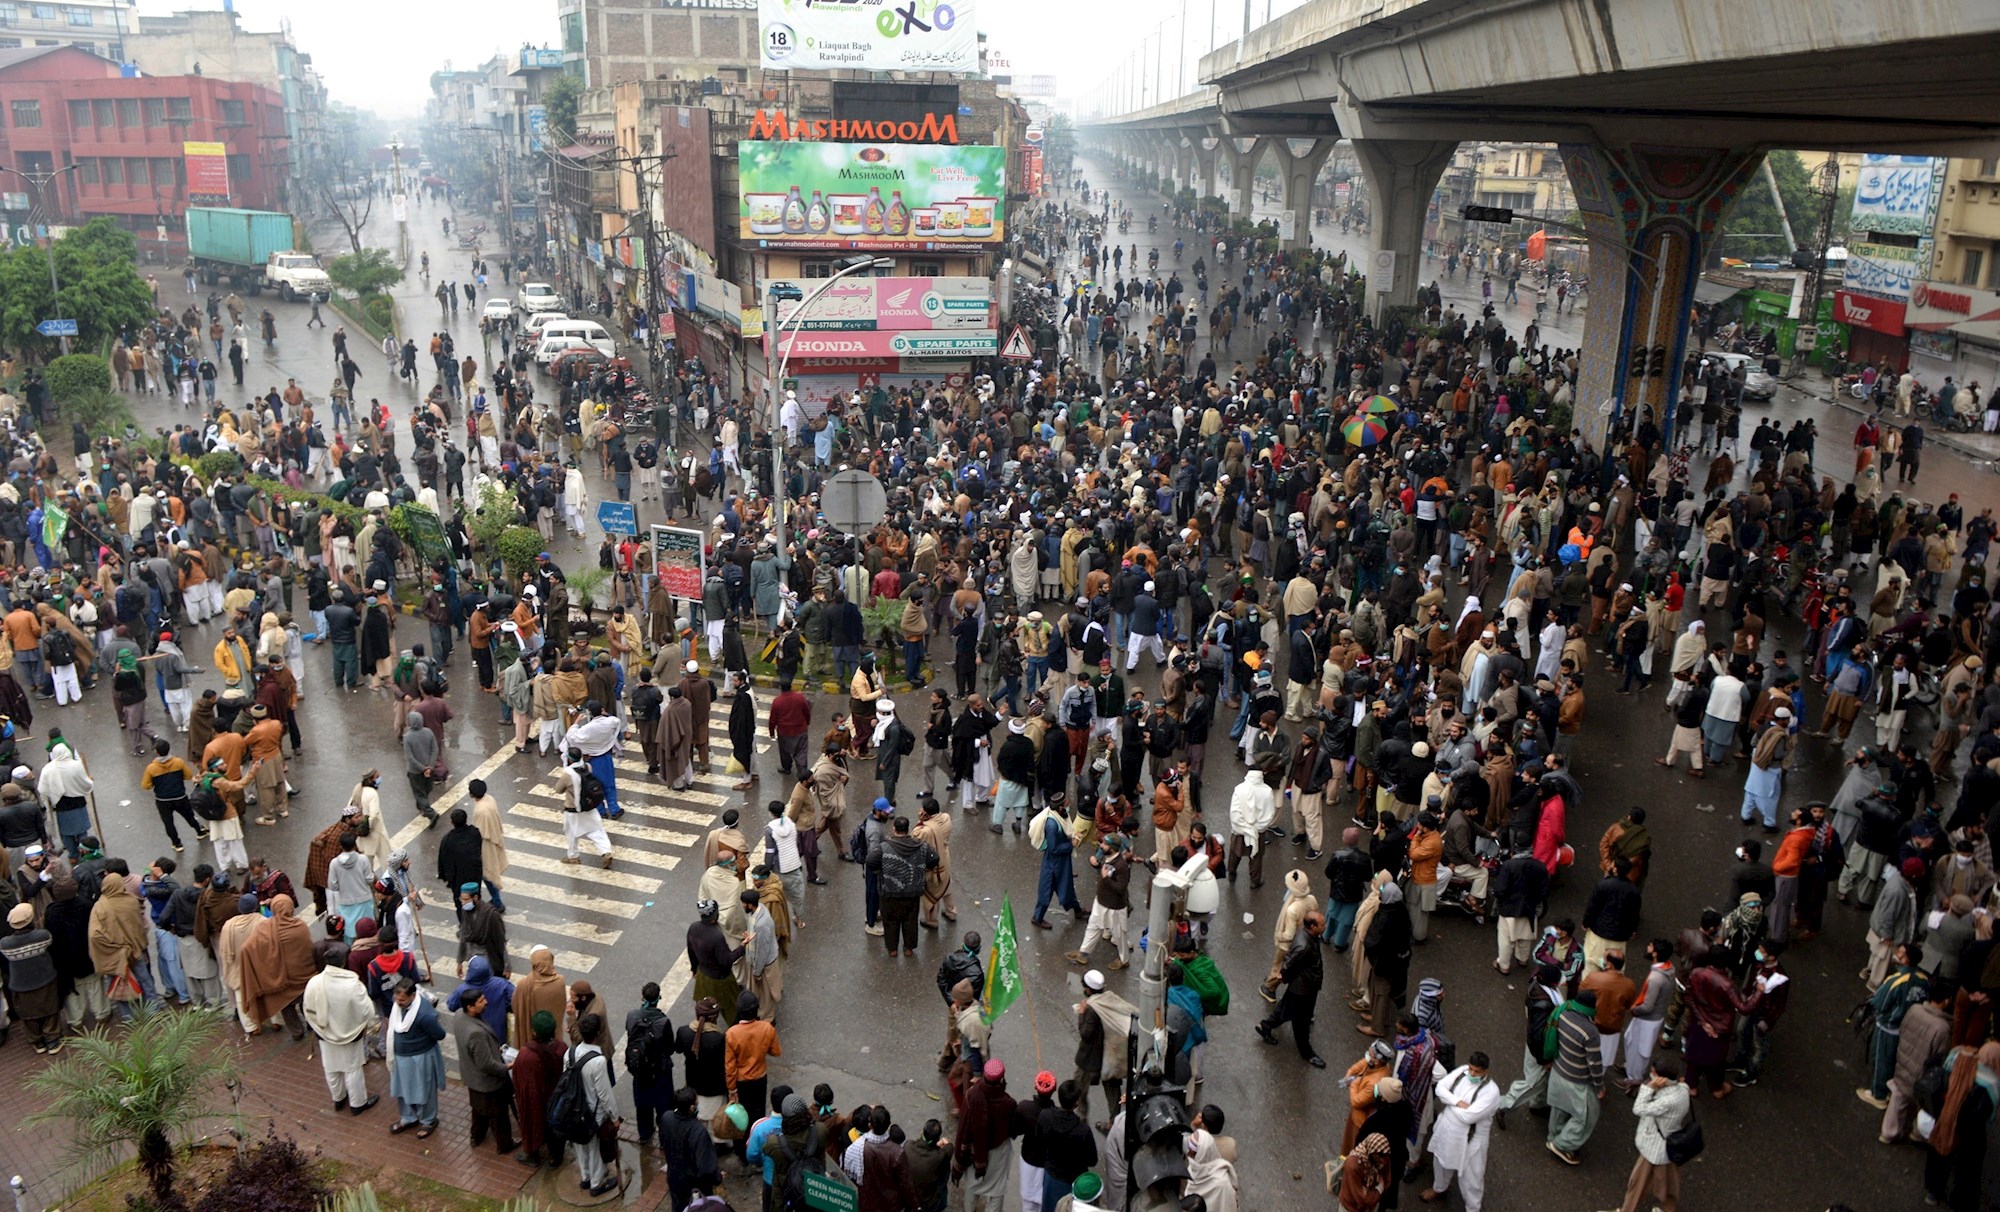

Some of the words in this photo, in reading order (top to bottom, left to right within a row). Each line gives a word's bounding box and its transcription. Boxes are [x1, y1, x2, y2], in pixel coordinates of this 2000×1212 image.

[770, 32, 787, 45] 18
[819, 41, 849, 51] Liaquat
[852, 42, 872, 52] Bagh
[819, 52, 864, 62] Rawalpindi
[988, 60, 1010, 68] OTEL
[931, 167, 944, 175] Eat
[946, 167, 965, 176] Well,
[938, 174, 955, 182] Live
[957, 174, 979, 182] Fresh
[1922, 174, 1943, 235] CLINIC
[858, 241, 890, 250] Mashmoom
[1848, 240, 1877, 256] Khan
[1850, 307, 1872, 321] TCS
[796, 341, 867, 352] HONDA
[917, 340, 953, 349] SPARE
[956, 340, 992, 348] PARTS
[803, 358, 888, 367] HONDA
[807, 1178, 828, 1191] GREEN
[828, 1187, 853, 1200] NATION
[808, 1188, 828, 1201] CLEAN
[828, 1196, 853, 1210] NATION
